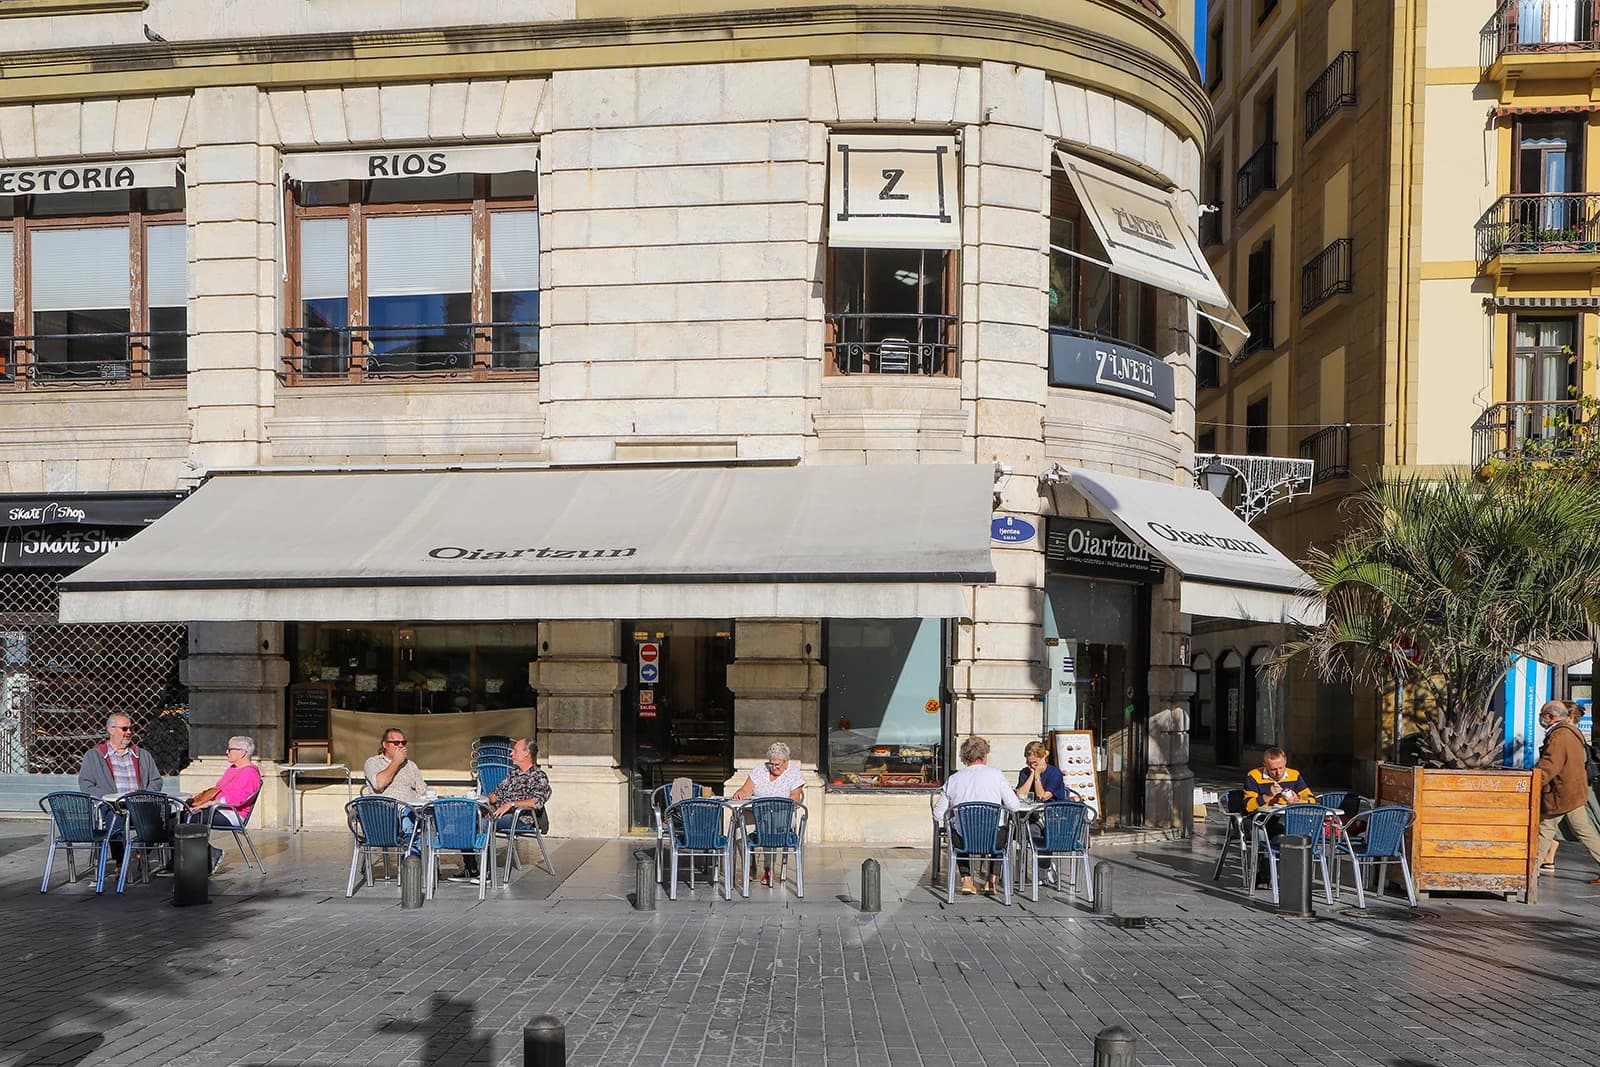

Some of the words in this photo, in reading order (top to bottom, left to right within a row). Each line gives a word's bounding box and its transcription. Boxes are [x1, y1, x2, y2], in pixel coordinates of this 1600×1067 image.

[368, 153, 447, 177] RIOS
[0, 166, 135, 193] ESTORIA
[879, 169, 909, 200] Z
[9, 508, 43, 520] Skate
[57, 506, 86, 522] Shop
[23, 529, 83, 554] Skate
[83, 529, 128, 553] Sho
[1067, 528, 1150, 562] Oiartzun
[1147, 521, 1269, 555] Oiartzun
[428, 546, 638, 560] Oiartzun
